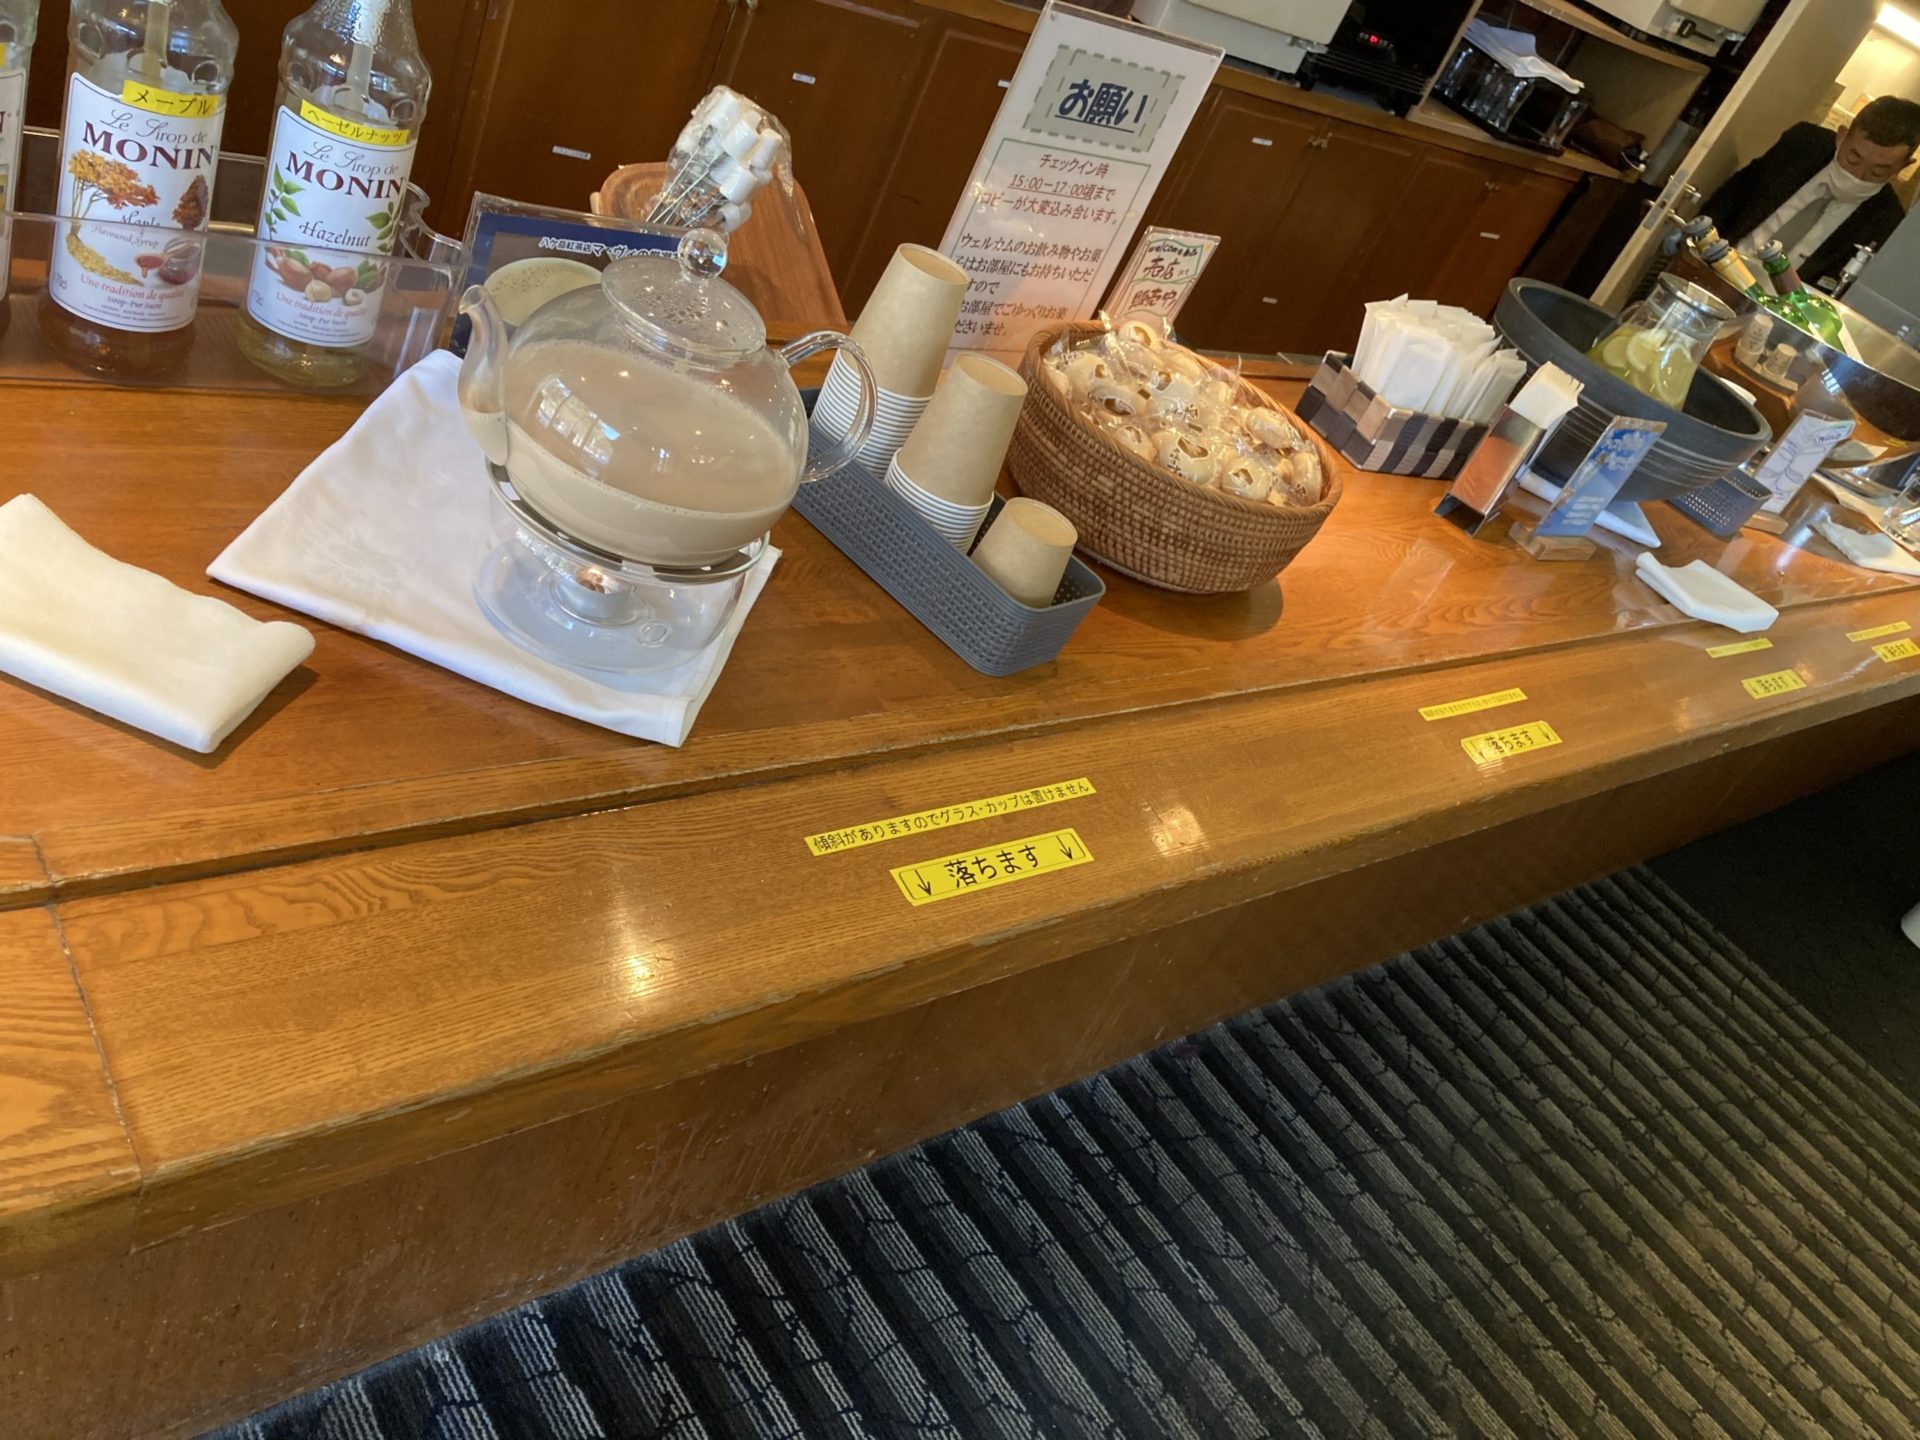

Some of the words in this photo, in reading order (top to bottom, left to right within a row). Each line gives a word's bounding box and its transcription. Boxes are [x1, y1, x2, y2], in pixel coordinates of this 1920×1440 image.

[133, 90, 211, 115] メープル
[1058, 78, 1149, 127] お願い
[100, 109, 133, 132] Le
[136, 118, 187, 145] Sirop
[191, 131, 208, 144] de
[308, 109, 403, 143] ヘーゼルナッツ
[82, 120, 214, 170] MONIN
[303, 141, 333, 163] Le
[334, 151, 381, 178] Sirop
[384, 164, 399, 176] de
[286, 150, 405, 199] MONIN
[1039, 154, 1110, 179] チェックイン時
[299, 220, 371, 248] Hazelnut
[961, 233, 1104, 264] ウェルカムのお飲み物やお菓
[80, 274, 98, 289] Une
[101, 283, 145, 300] tradition
[943, 843, 1039, 889] 落ちます
